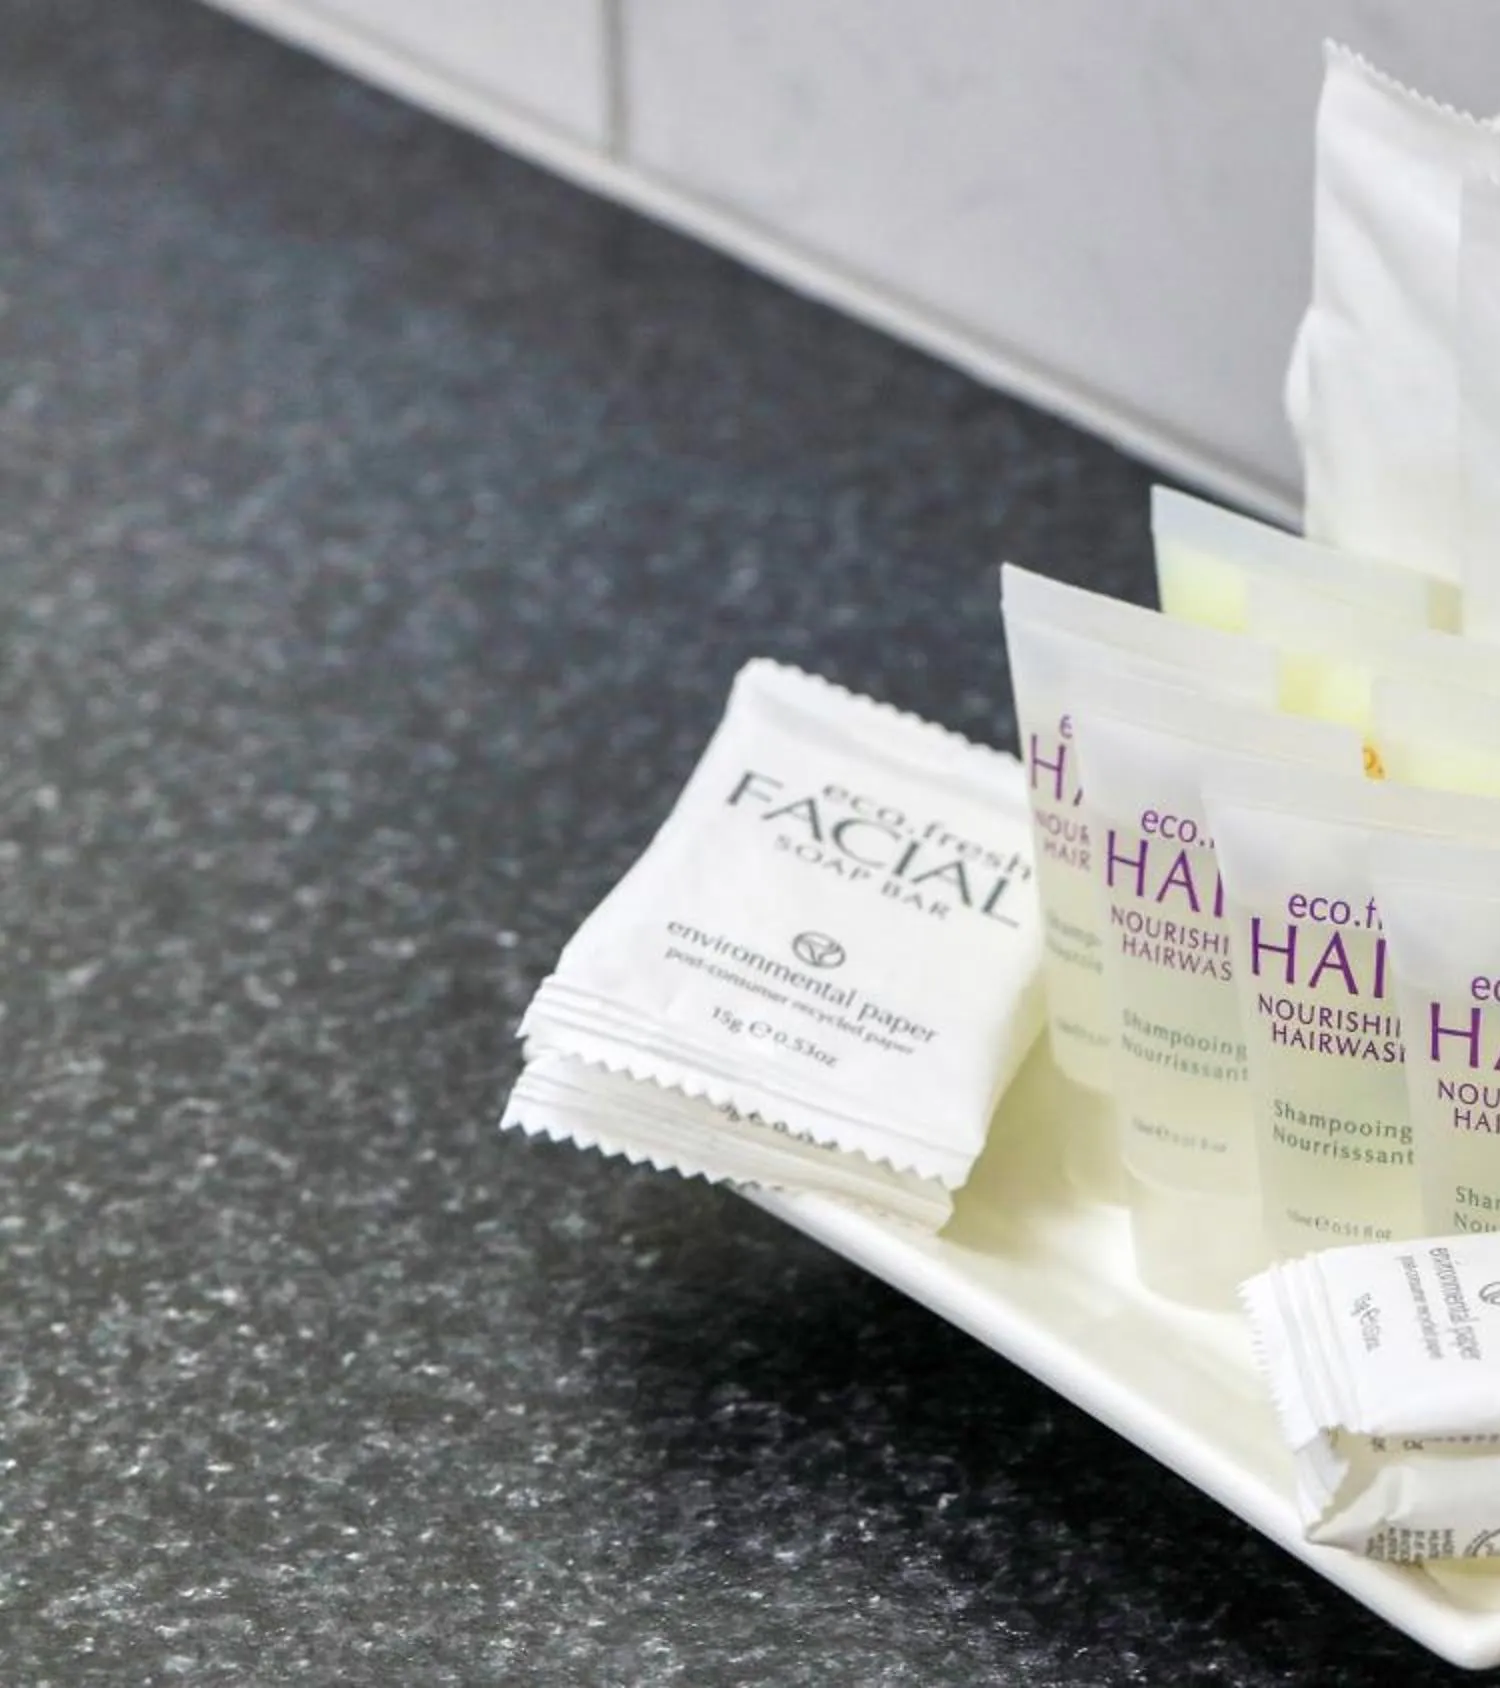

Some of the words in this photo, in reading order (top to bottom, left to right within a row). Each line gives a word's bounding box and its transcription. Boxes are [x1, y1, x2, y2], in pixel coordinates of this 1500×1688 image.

[726, 770, 1019, 929] FACIAL
[822, 783, 1032, 882] eco.fresh
[773, 834, 872, 881] SOAP
[880, 880, 951, 921] BAR
[1111, 904, 1230, 957] NOURISHI
[1122, 933, 1233, 983] HAIRWAS
[1251, 917, 1387, 999] HAI
[664, 945, 789, 1006] post-consumer
[791, 999, 867, 1039] recycled
[862, 1030, 916, 1056] paper
[666, 919, 858, 1009] environmental
[857, 1000, 939, 1044] paper
[711, 1005, 744, 1035] 15g
[1122, 1007, 1248, 1063] Shampooing
[1274, 1099, 1413, 1146] Shampooing
